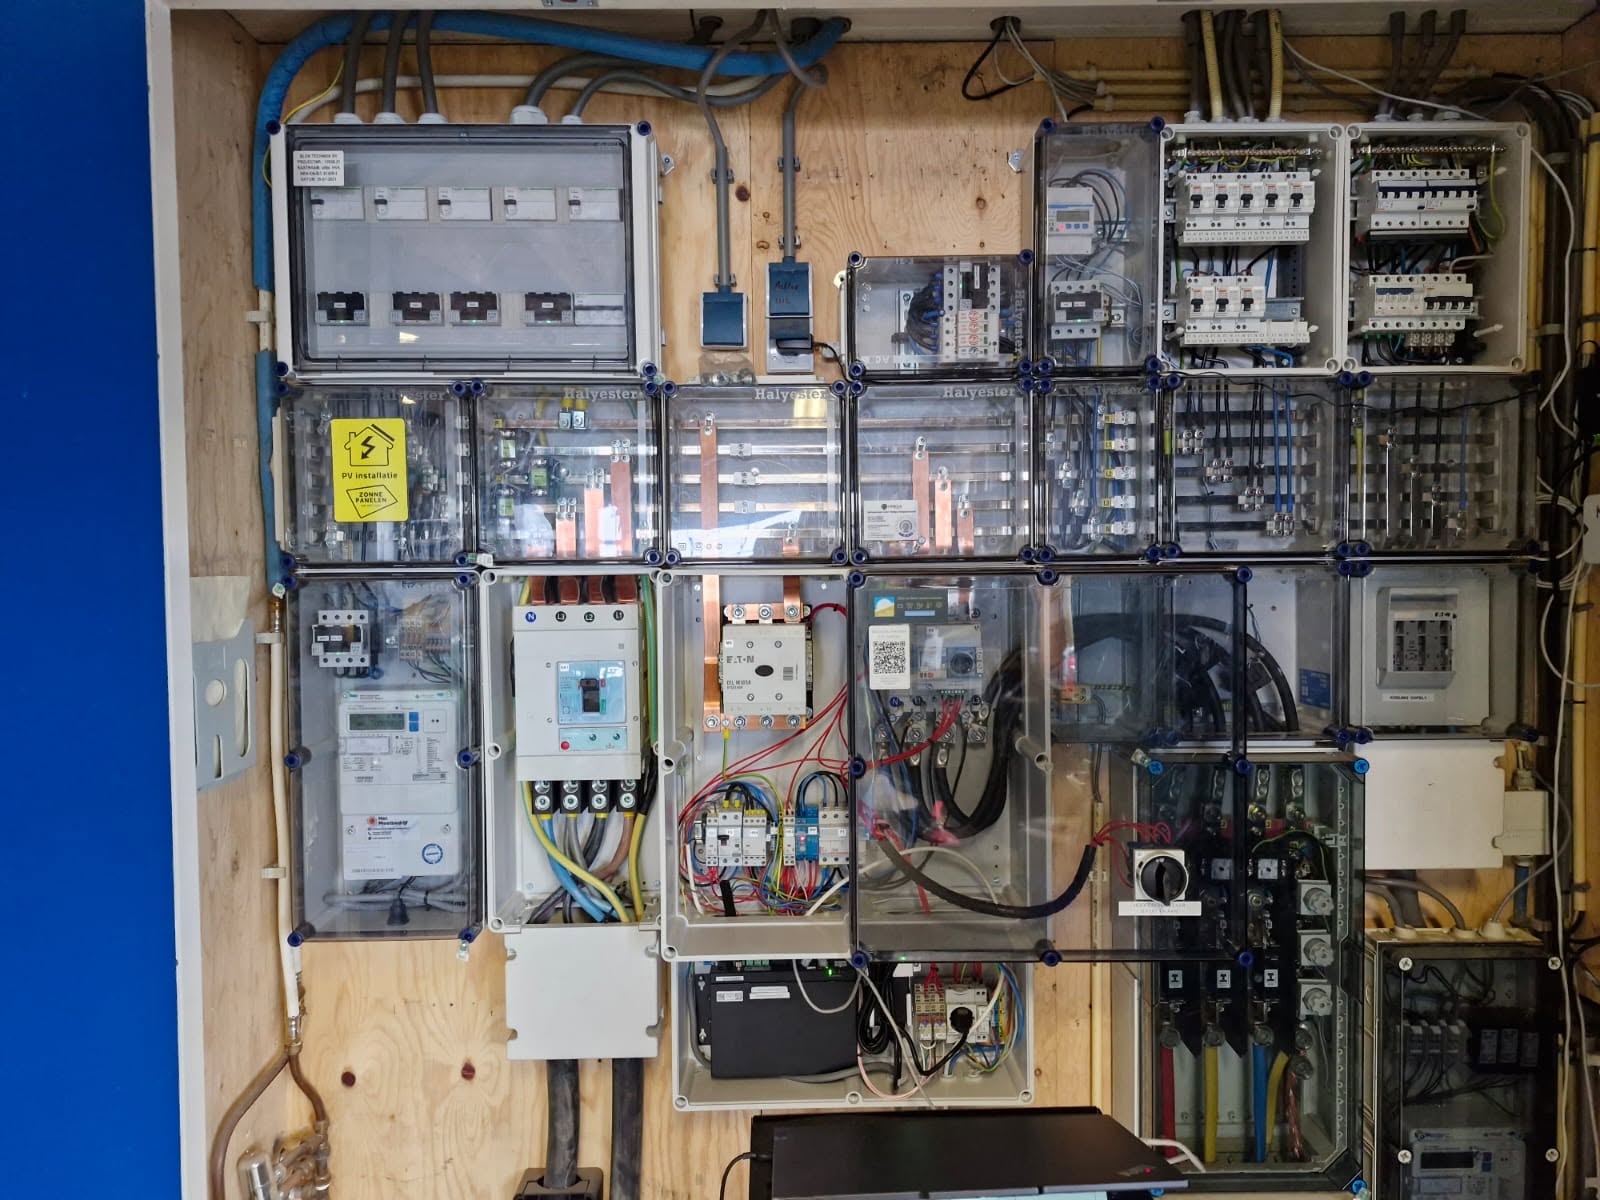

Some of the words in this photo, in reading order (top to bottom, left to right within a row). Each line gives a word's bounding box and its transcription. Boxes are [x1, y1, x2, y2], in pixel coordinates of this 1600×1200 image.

[564, 387, 638, 403] Halyester
[755, 388, 827, 403] Halyester
[943, 386, 1016, 401] Halyester
[341, 472, 353, 480] PV
